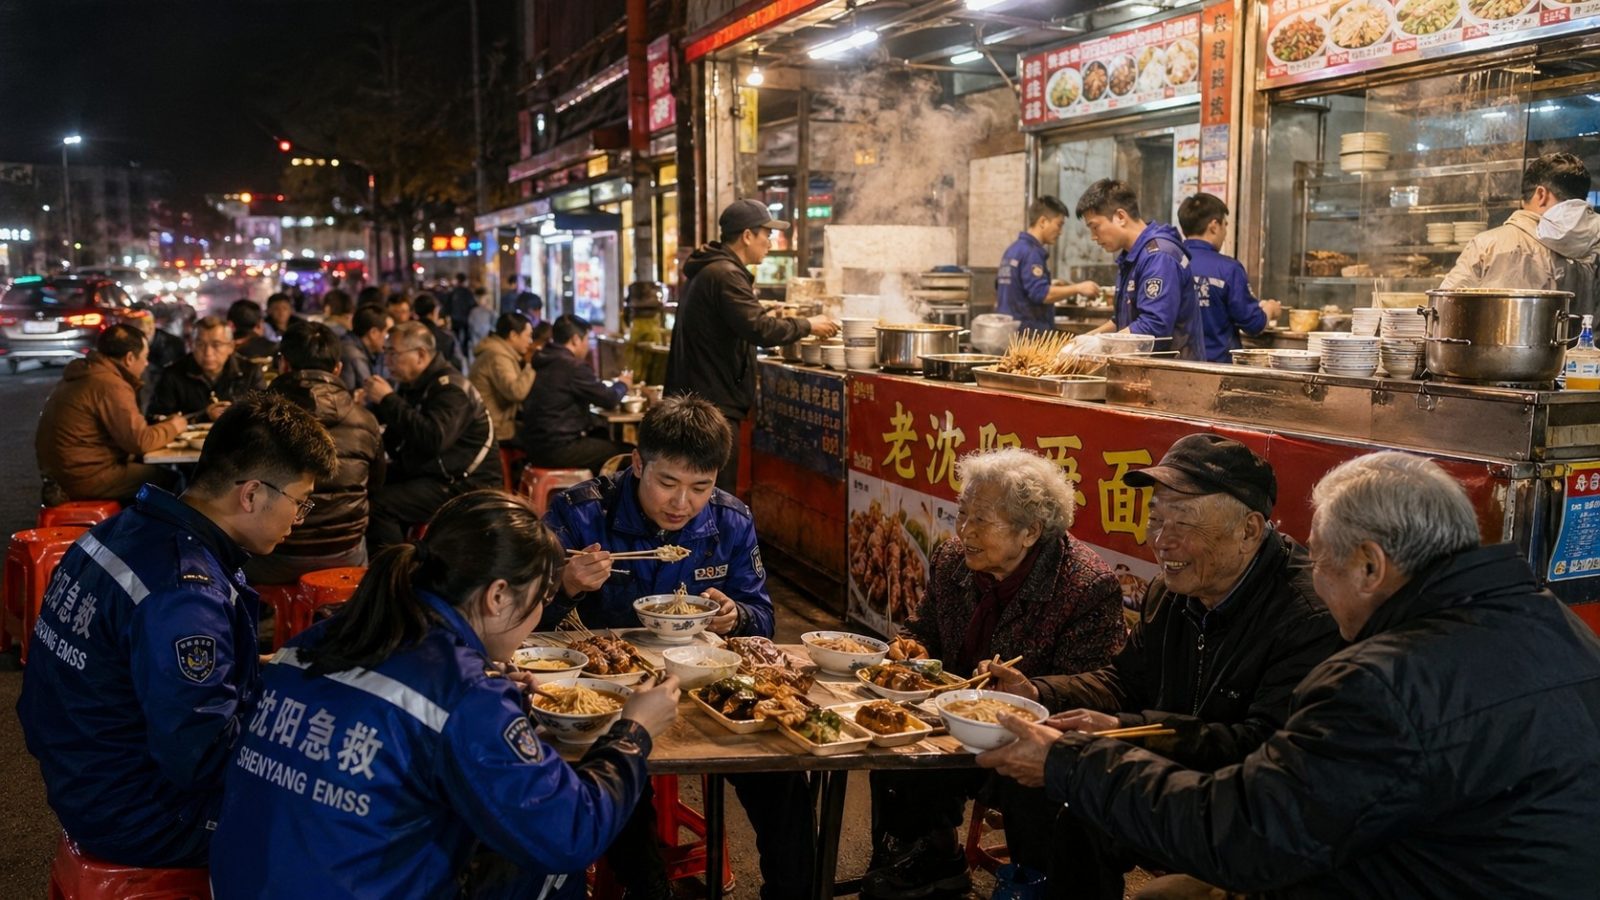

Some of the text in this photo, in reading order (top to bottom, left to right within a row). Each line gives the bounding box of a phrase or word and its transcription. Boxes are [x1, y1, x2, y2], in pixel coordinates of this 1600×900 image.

[56, 638, 87, 670] EMSS
[249, 690, 383, 780] 沈阳急救
[237, 746, 371, 817] SHENYANG EMSS
